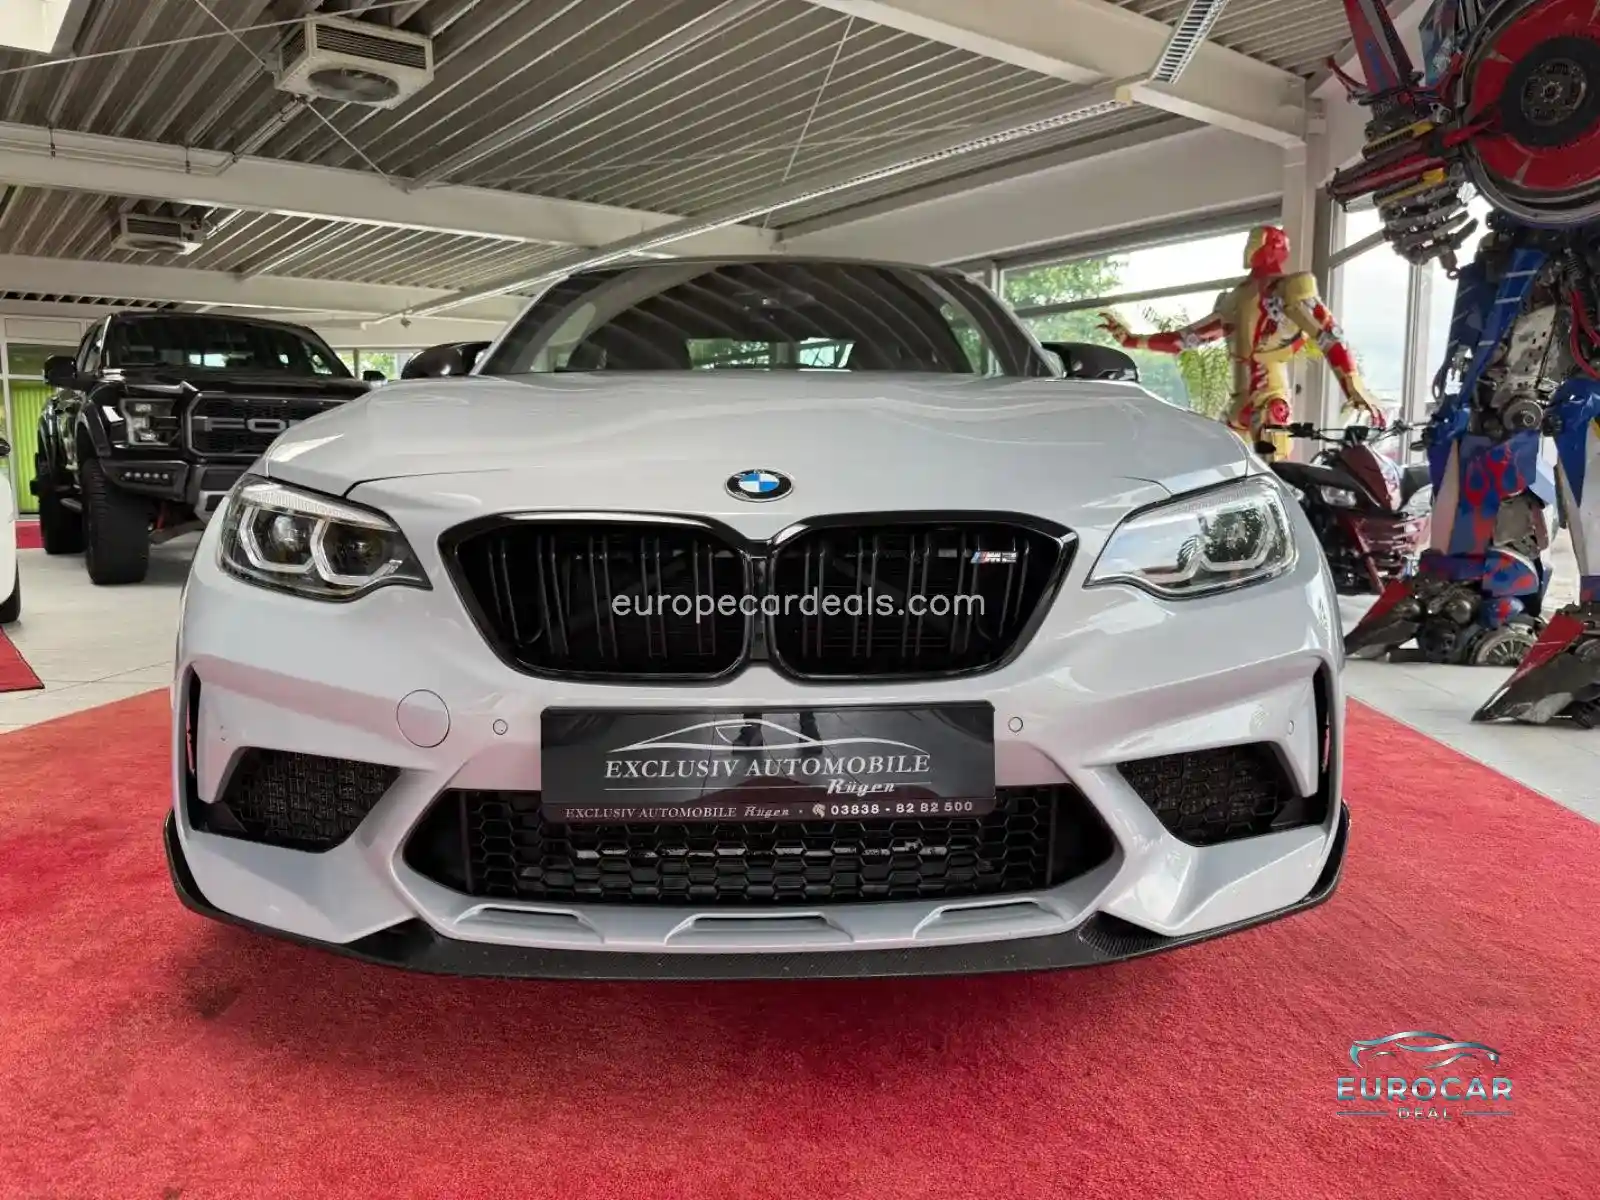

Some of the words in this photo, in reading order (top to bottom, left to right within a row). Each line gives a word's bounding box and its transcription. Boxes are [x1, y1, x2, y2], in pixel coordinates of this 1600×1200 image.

[603, 759, 740, 779] EXCLUSIV
[745, 754, 931, 778] AUTOMOBILE
[827, 778, 895, 797] Rügen
[565, 807, 635, 818] EXCLUSIV
[638, 806, 737, 818] AUTOMOBILE
[744, 804, 790, 819] Rügen
[830, 803, 880, 816] 03838
[896, 802, 915, 814] 82
[920, 802, 939, 814] 82
[943, 801, 973, 813] 500
